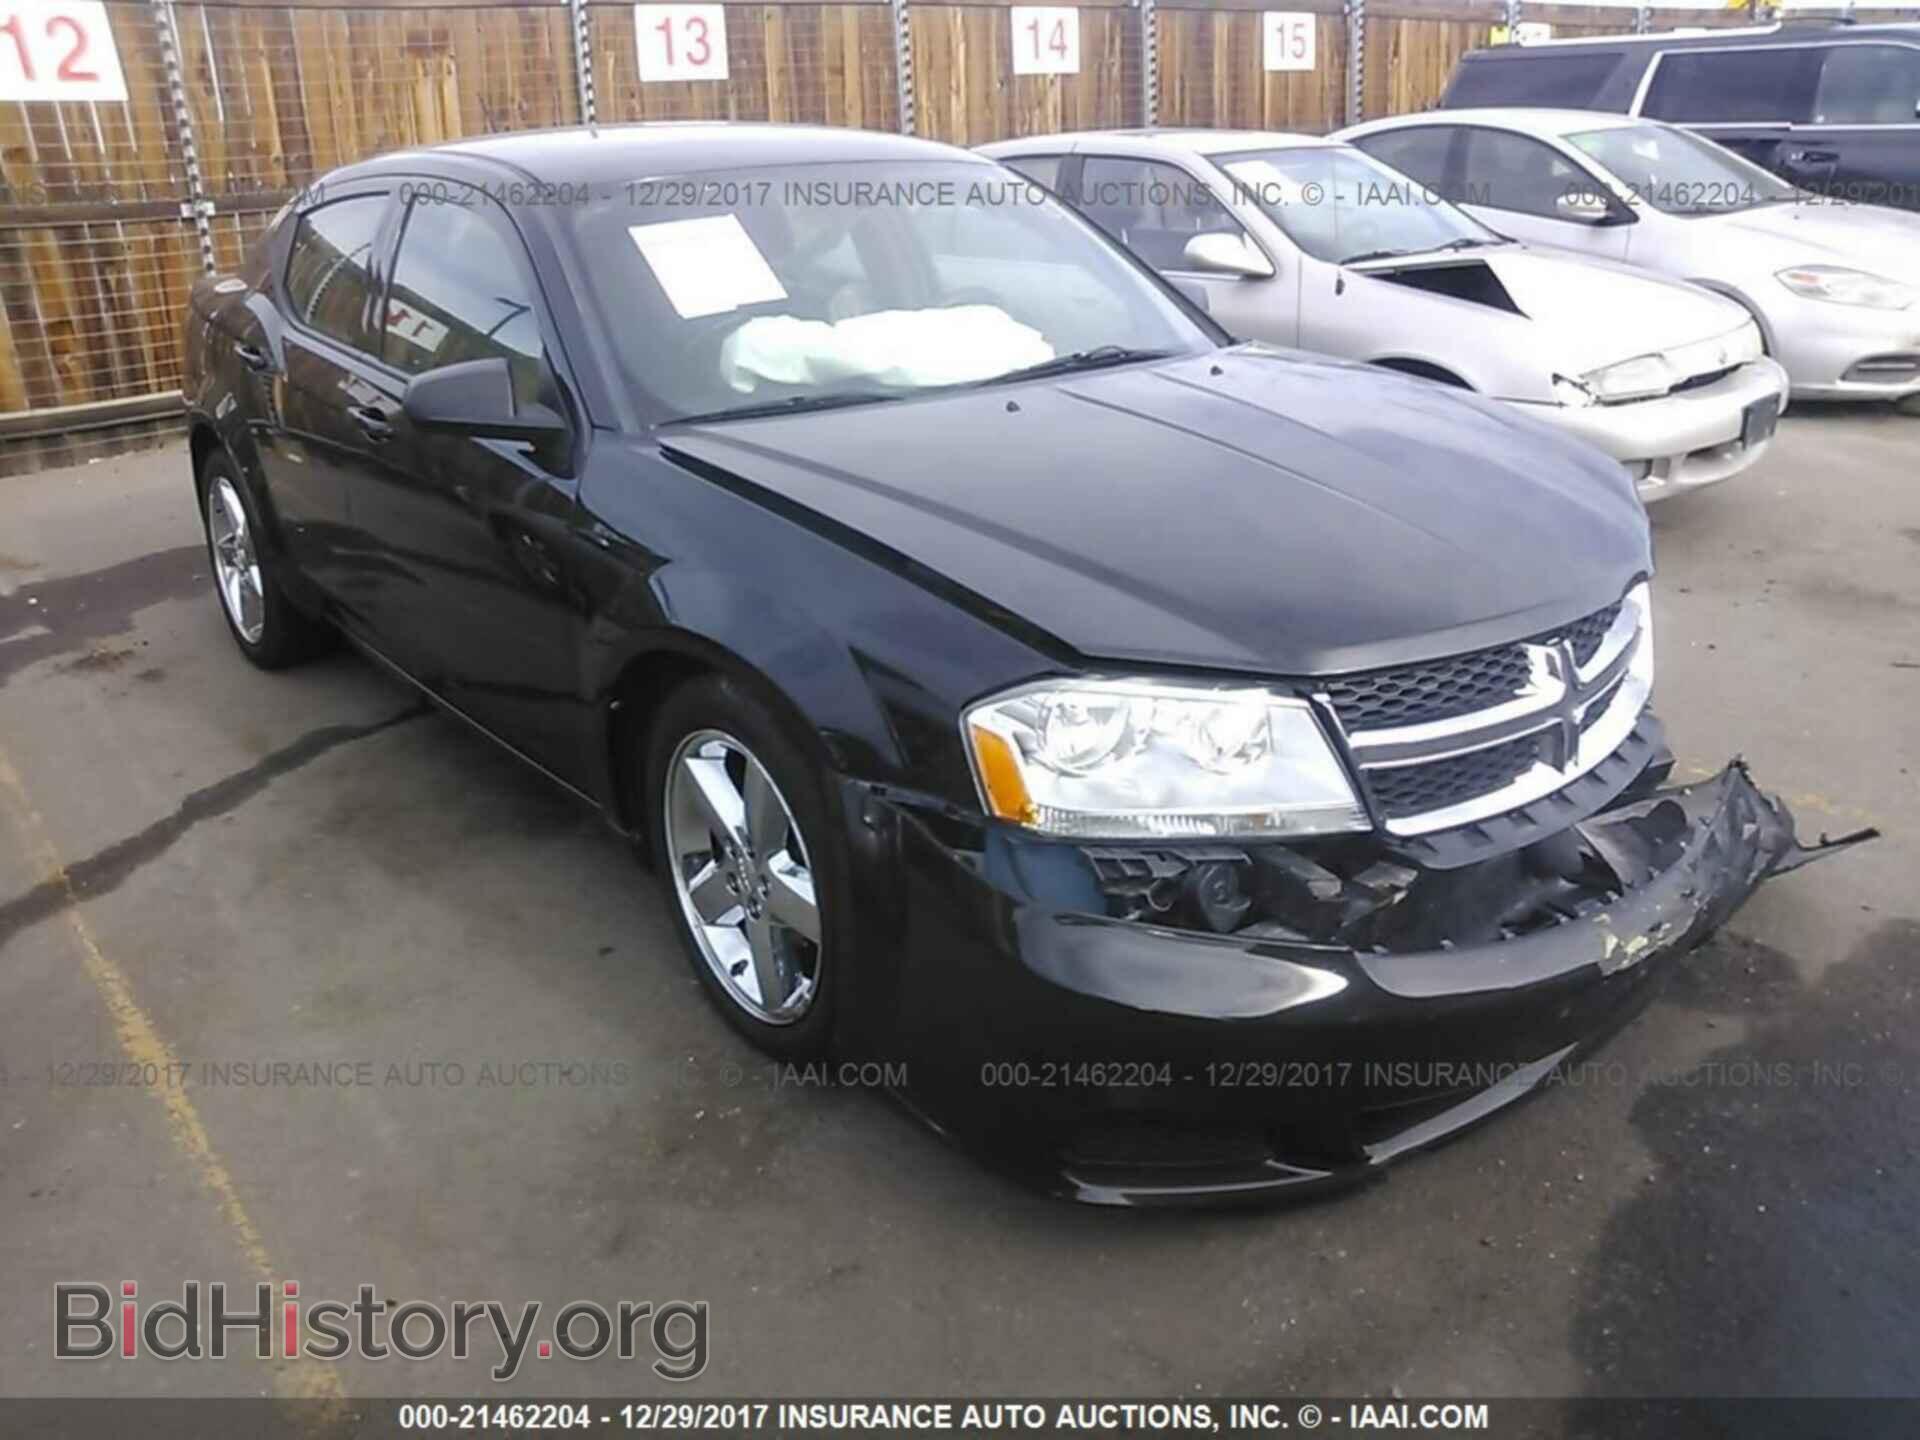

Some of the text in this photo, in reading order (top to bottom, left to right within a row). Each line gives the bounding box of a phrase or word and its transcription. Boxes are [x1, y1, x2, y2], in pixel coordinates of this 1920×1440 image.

[0, 14, 100, 82] 12
[654, 16, 711, 66] 13
[1027, 18, 1067, 60] 14
[1275, 22, 1307, 59] 15
